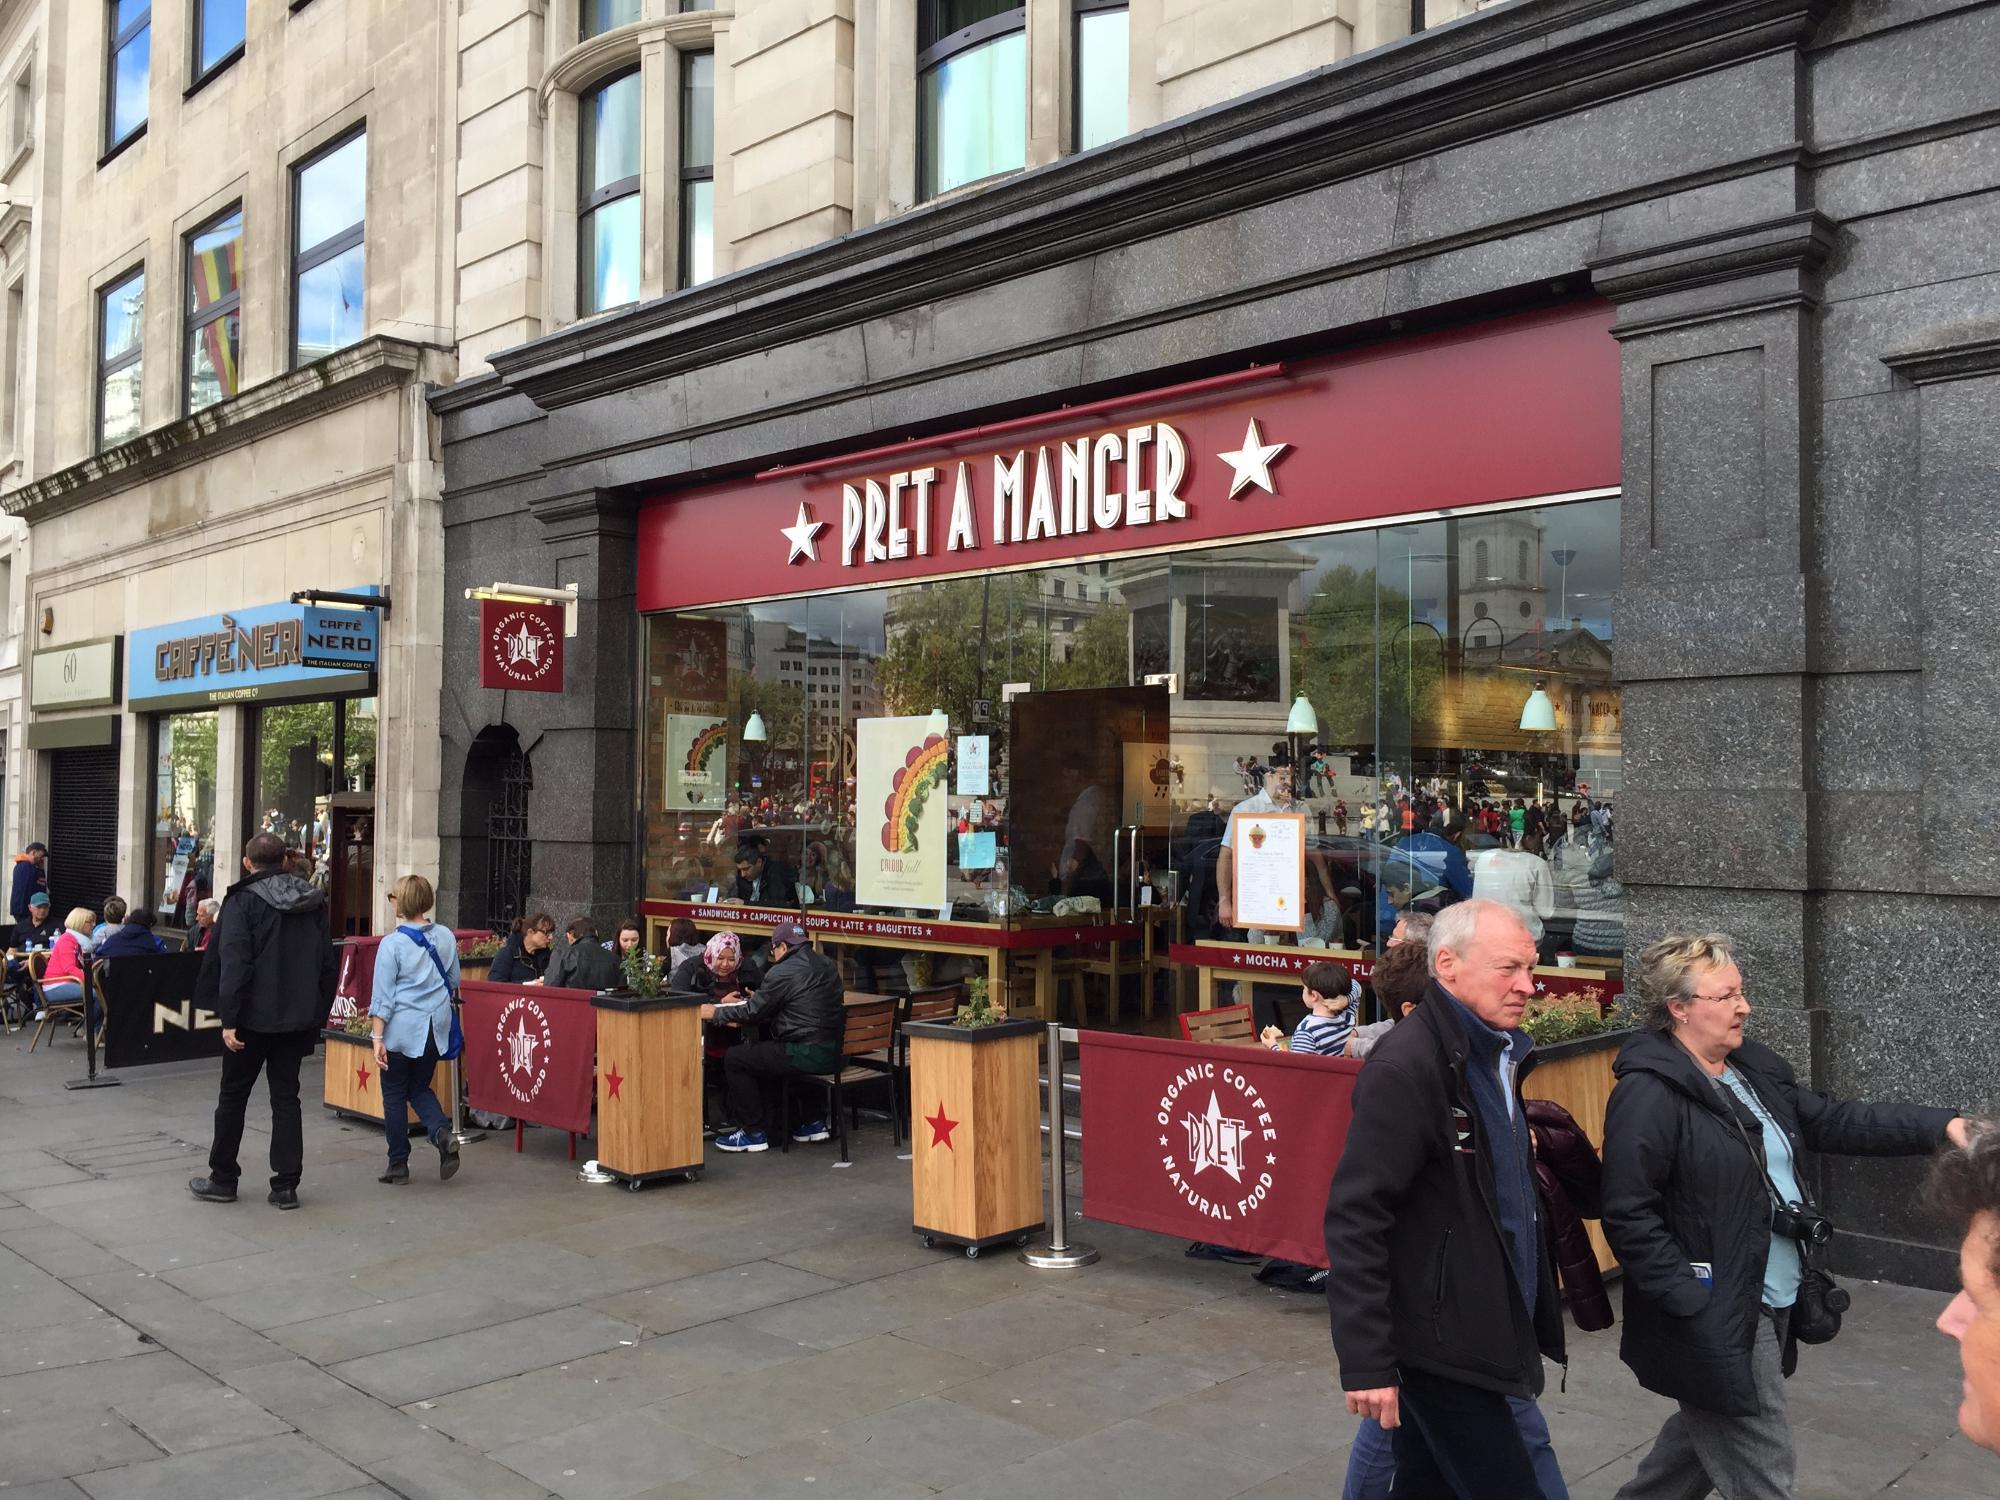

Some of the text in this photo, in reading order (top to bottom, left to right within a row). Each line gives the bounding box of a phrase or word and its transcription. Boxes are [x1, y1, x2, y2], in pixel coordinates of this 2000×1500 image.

[841, 421, 1189, 567] PRET A MANGER
[308, 633, 372, 651] NERO
[492, 611, 555, 646] ORGANIC COFFEE
[155, 614, 303, 682] CAFFÈ NER
[507, 633, 542, 661] PRET
[63, 652, 77, 684] 60
[495, 654, 553, 681] NATURAL FOOD
[209, 692, 217, 701] THE
[217, 690, 235, 700] ITALIAN
[234, 688, 251, 699] COFFEE
[698, 908, 923, 936] SANDWICHES CAPPUCCINO SOUPS LATTE BAGUETTES
[1245, 954, 1288, 968] MOCHA
[153, 999, 223, 1034] NE
[496, 998, 551, 1048] ORGANIC COFFEE
[510, 1031, 536, 1068] PRET
[499, 1062, 546, 1103] NATURAL FOOD
[1157, 1063, 1277, 1141] ORGANIC COFFEE
[1187, 1111, 1246, 1171] PRET
[1162, 1155, 1273, 1220] NATURAL FOOD
